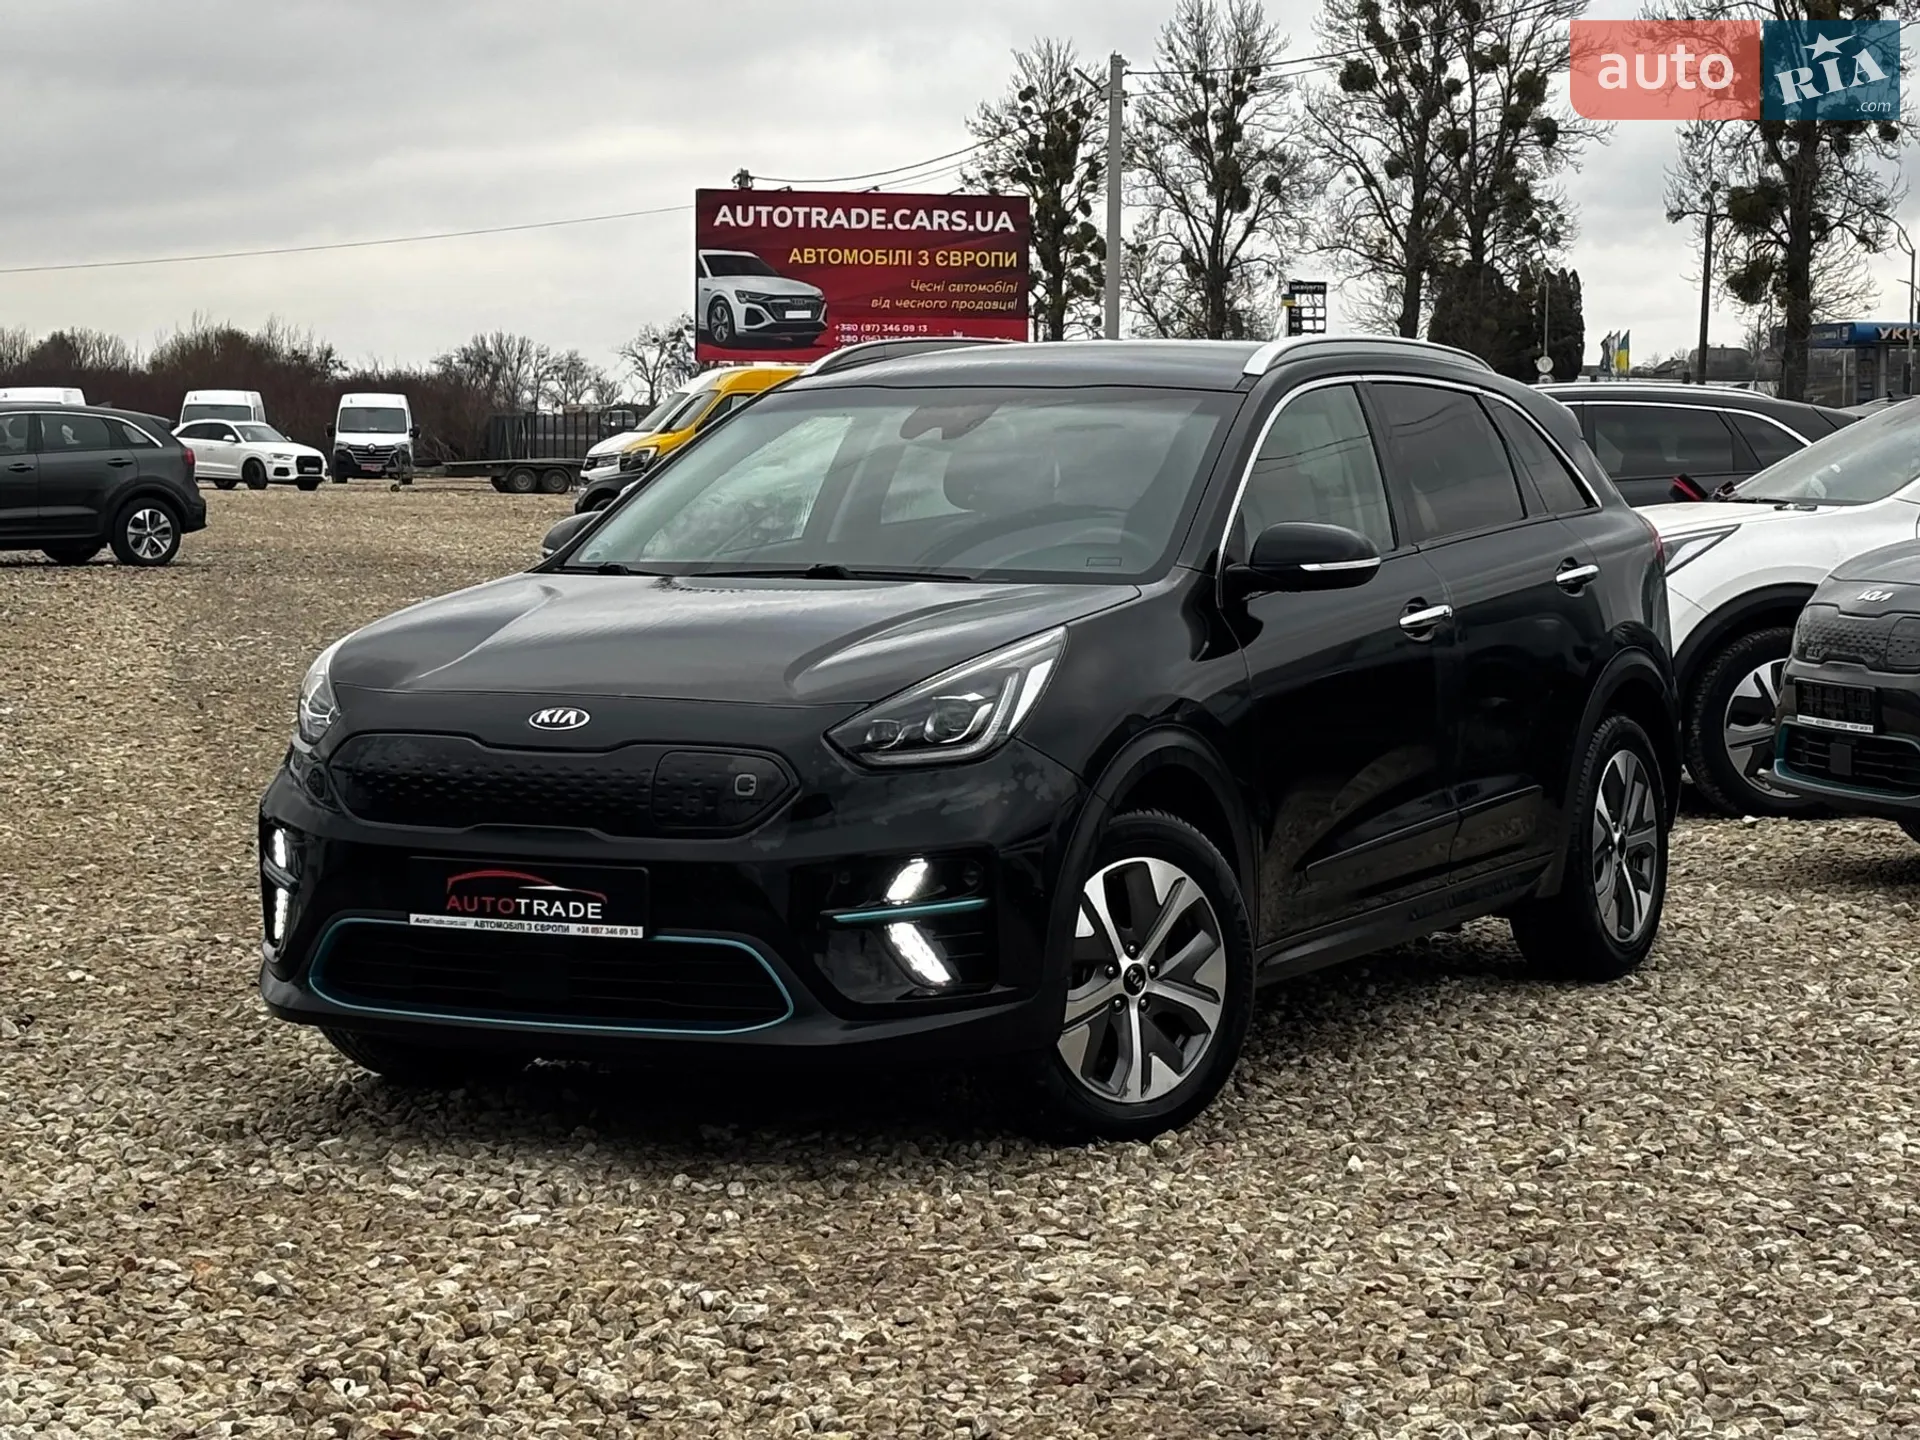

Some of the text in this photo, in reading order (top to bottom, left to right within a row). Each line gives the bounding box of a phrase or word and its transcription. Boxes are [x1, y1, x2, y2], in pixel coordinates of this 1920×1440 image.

[713, 205, 1016, 232] AUTOTRADE.CARS.UA
[788, 247, 913, 266] АВТОМОБІЛІ
[936, 250, 1018, 268] ЄВРОПИ
[911, 279, 1019, 293] Чесні автомобілі
[871, 296, 1018, 310] від чесного продавця!
[834, 323, 928, 333] +380 (97) 346 09 13
[535, 708, 578, 725] KIA
[446, 894, 603, 919] AUTOTRADE
[474, 920, 525, 931] АВТОМОБІЛІ
[534, 922, 570, 933] ЄВРОПИ
[1127, 968, 1144, 991] KIA
